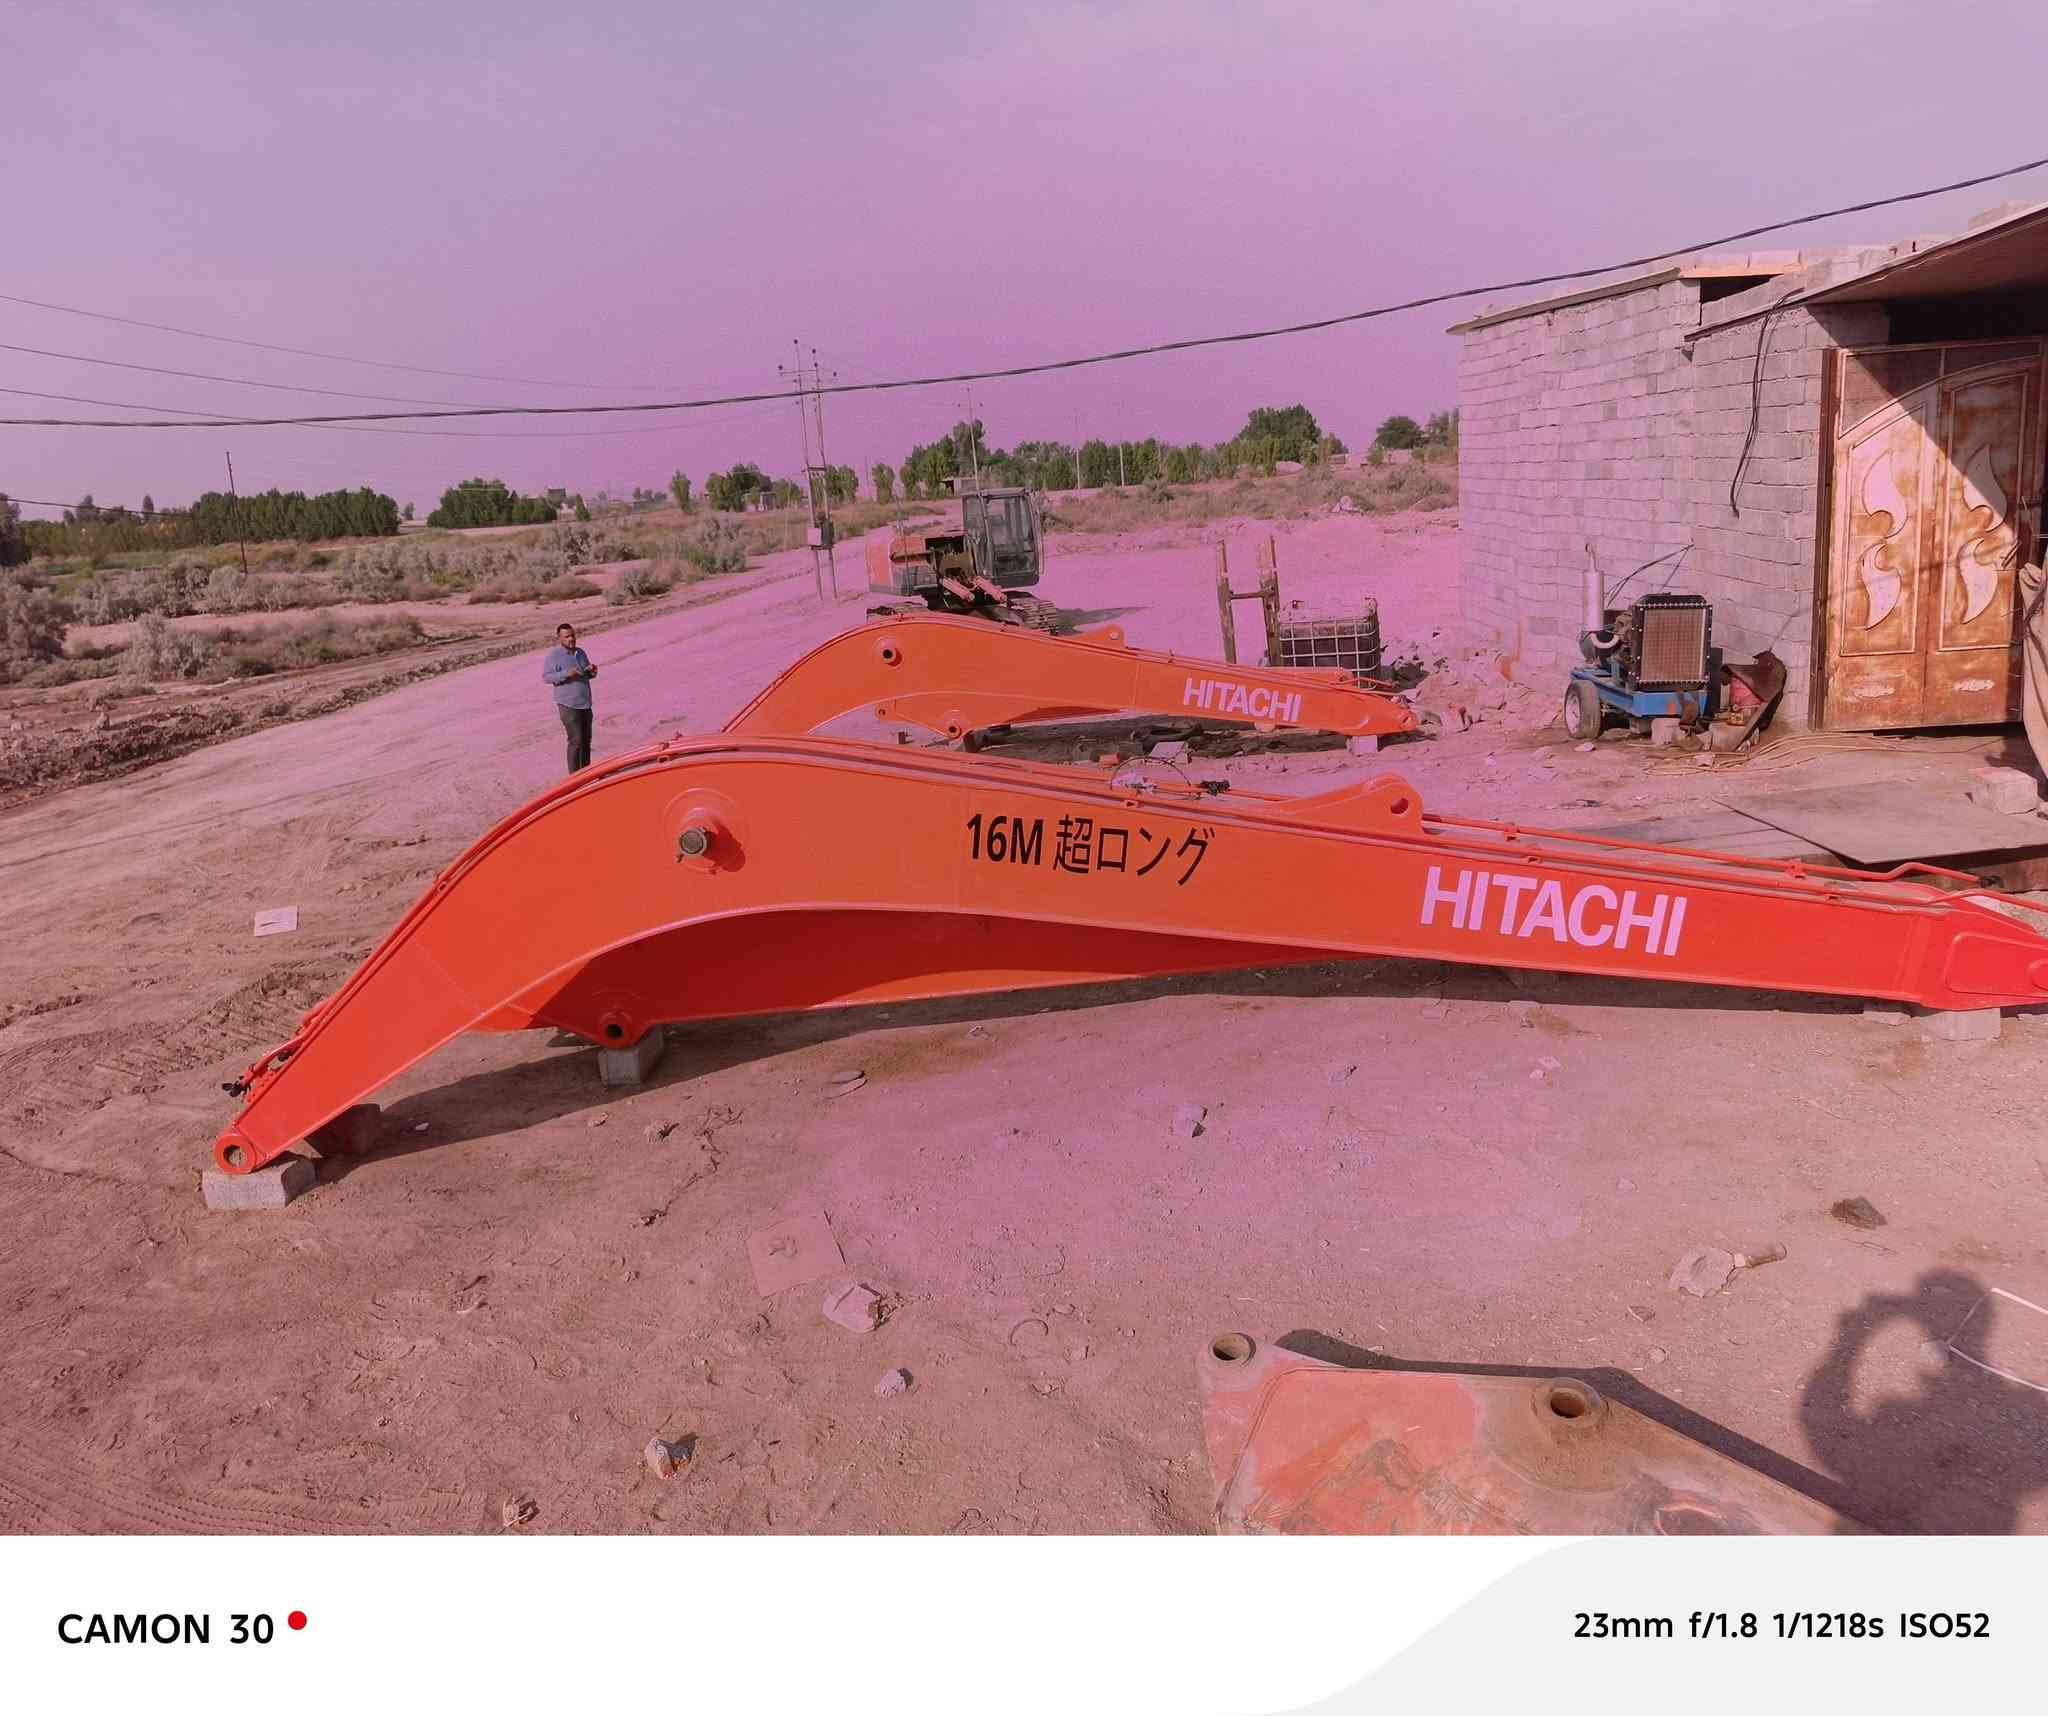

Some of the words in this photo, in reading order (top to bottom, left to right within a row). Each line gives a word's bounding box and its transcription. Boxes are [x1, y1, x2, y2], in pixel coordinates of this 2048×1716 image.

[1183, 677, 1302, 723] HITACHI
[966, 813, 1045, 866] 16M
[1052, 813, 1216, 886] 超ロング
[1420, 865, 1688, 957] HITACHI
